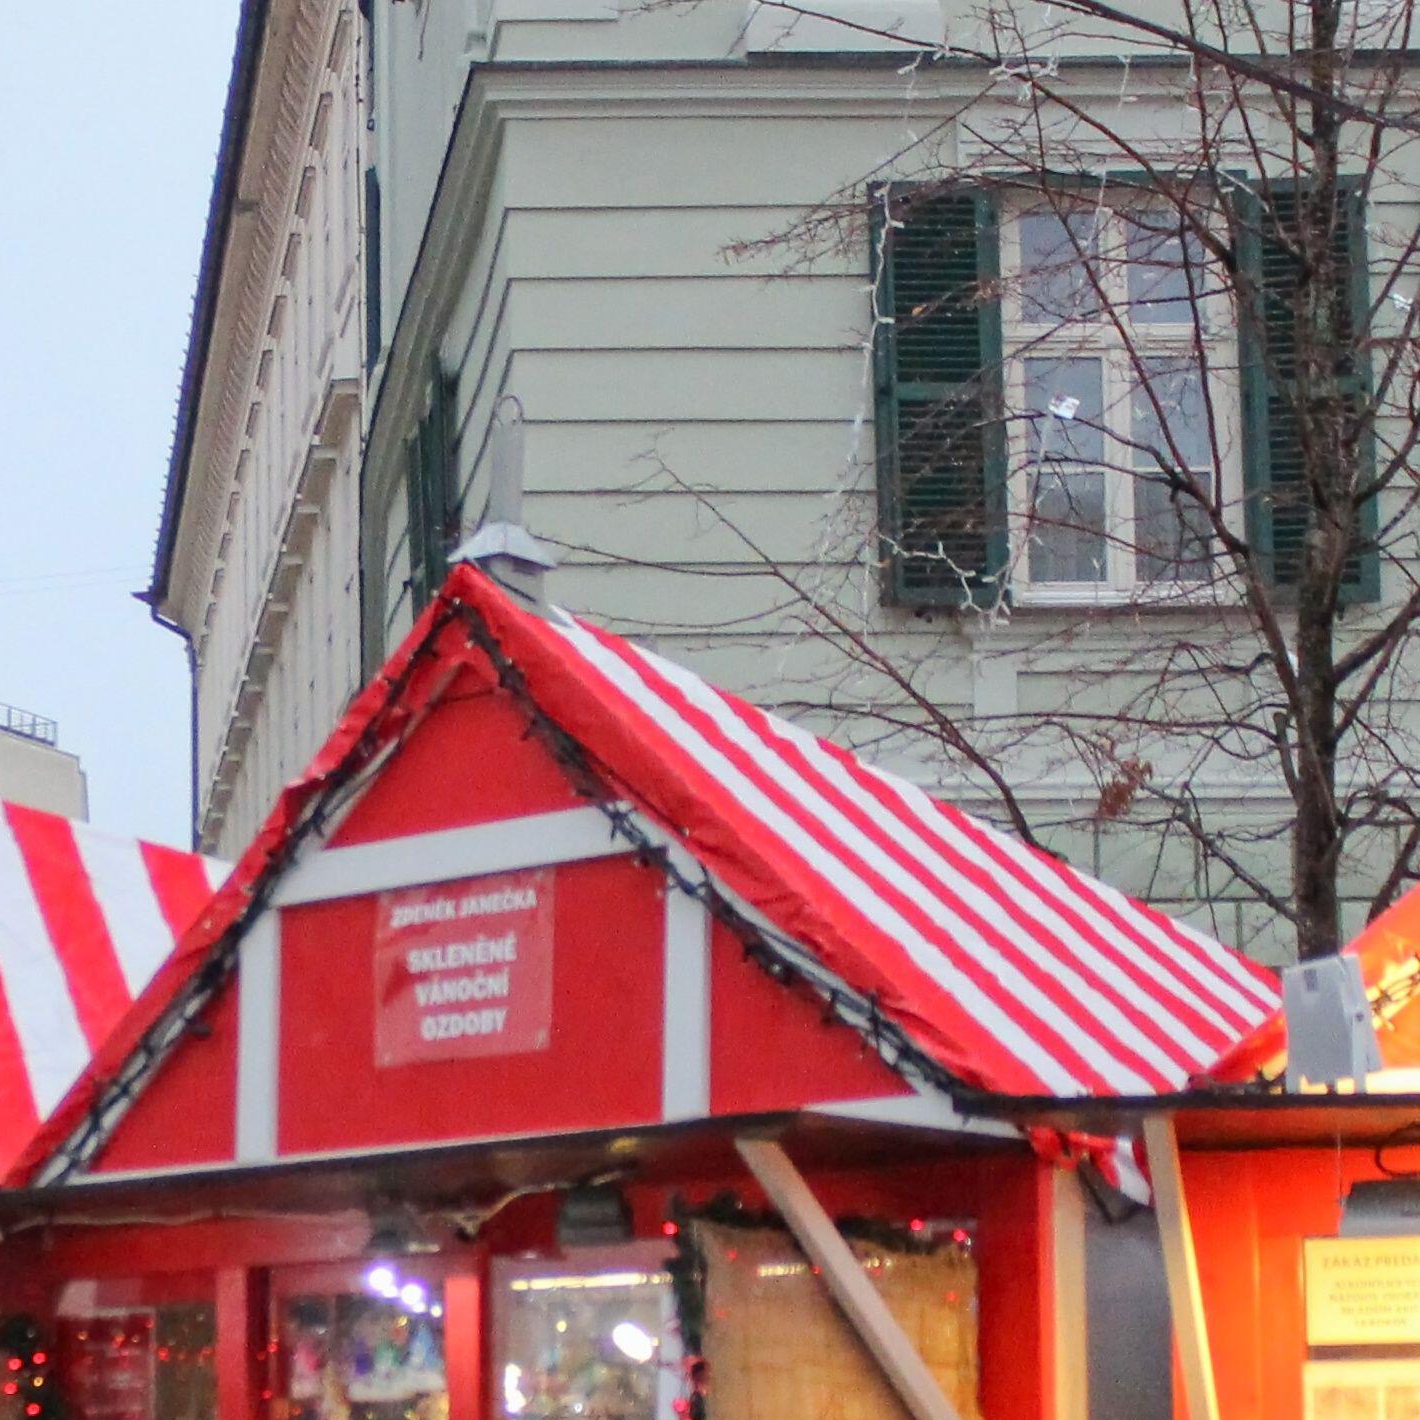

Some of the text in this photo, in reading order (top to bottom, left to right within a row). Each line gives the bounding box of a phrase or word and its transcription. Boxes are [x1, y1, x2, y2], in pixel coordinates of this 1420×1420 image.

[407, 931, 517, 974] SKLENĚNÉ
[415, 967, 510, 1007] VÁNOČNÍ
[420, 1007, 509, 1041] OZDOBY
